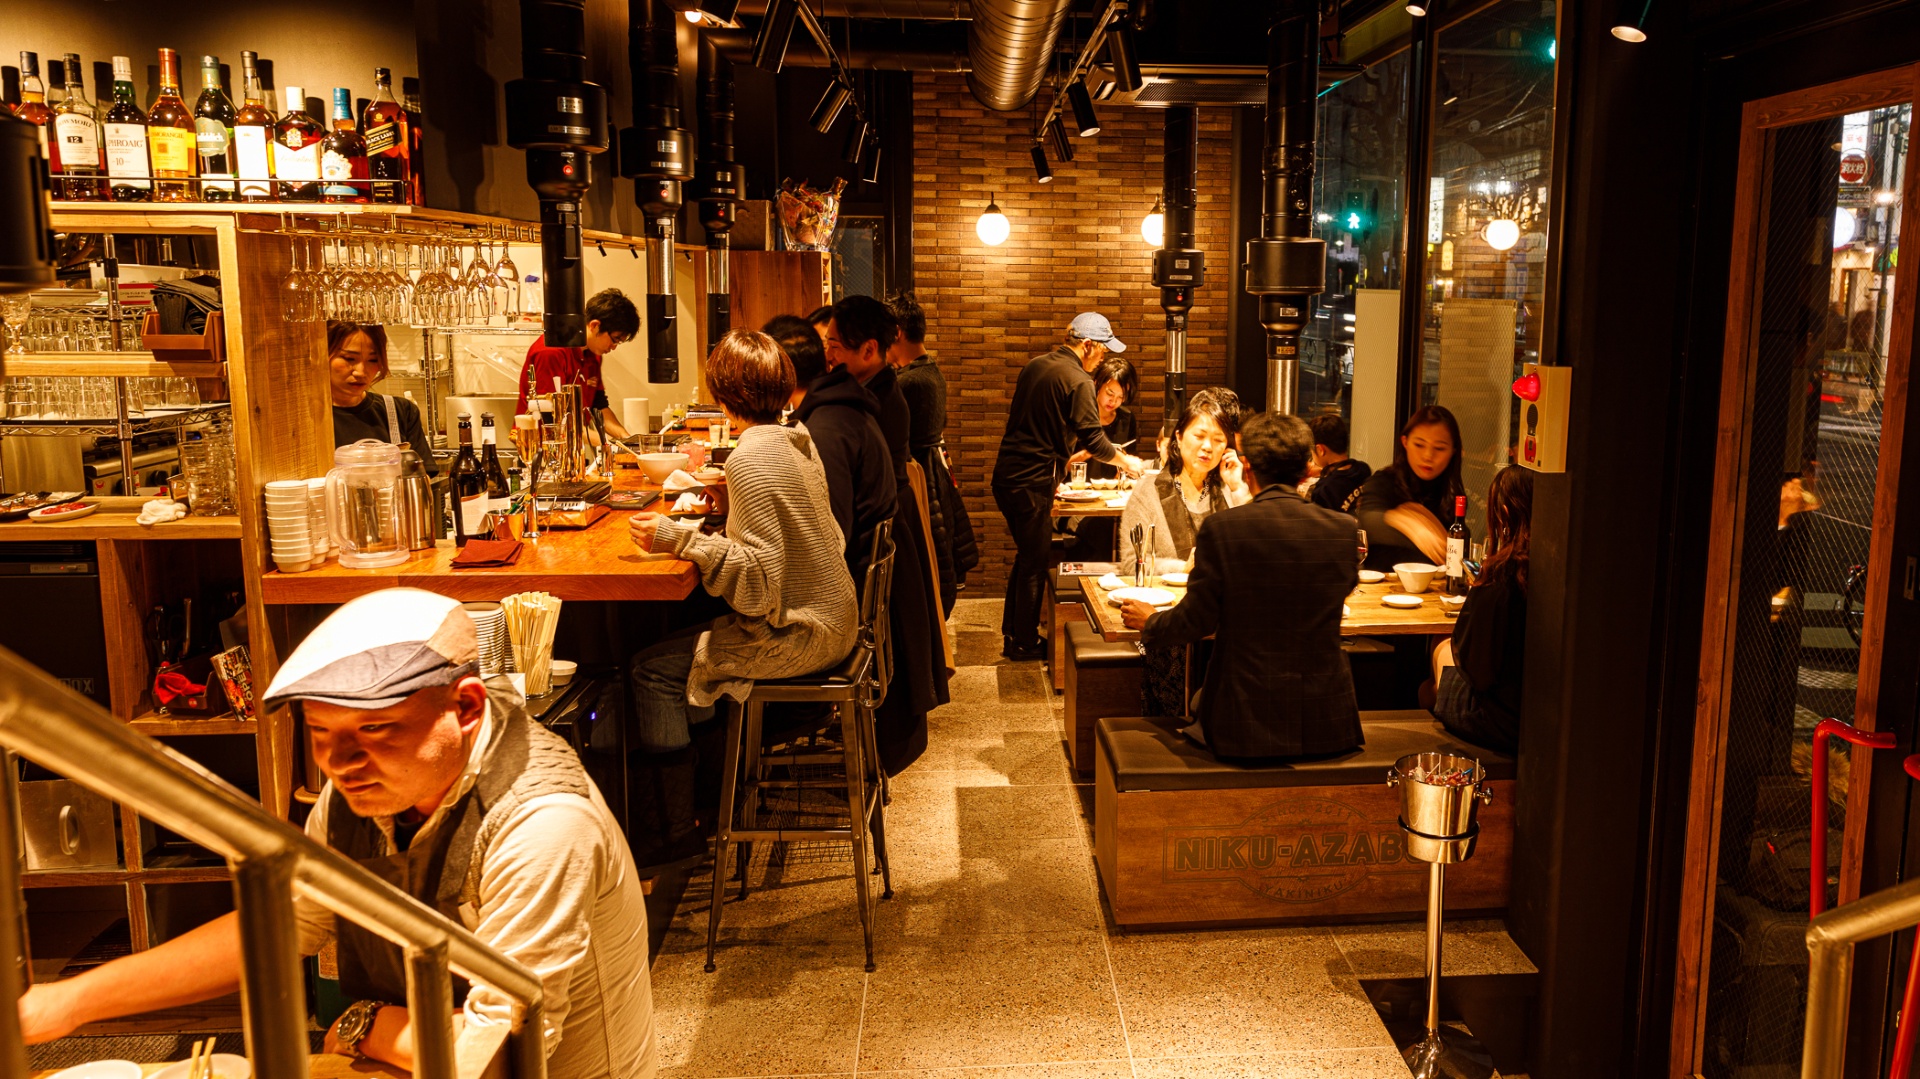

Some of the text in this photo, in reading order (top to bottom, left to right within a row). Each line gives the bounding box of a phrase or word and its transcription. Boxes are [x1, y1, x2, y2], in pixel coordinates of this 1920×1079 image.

[107, 139, 143, 148] PHROAIG
[115, 157, 124, 166] 10
[1841, 162, 1864, 174] 消火栓
[235, 662, 254, 702] OPEN
[1174, 831, 1424, 873] NIKU-AZAB
[1265, 881, 1344, 899] YAKINIKU
